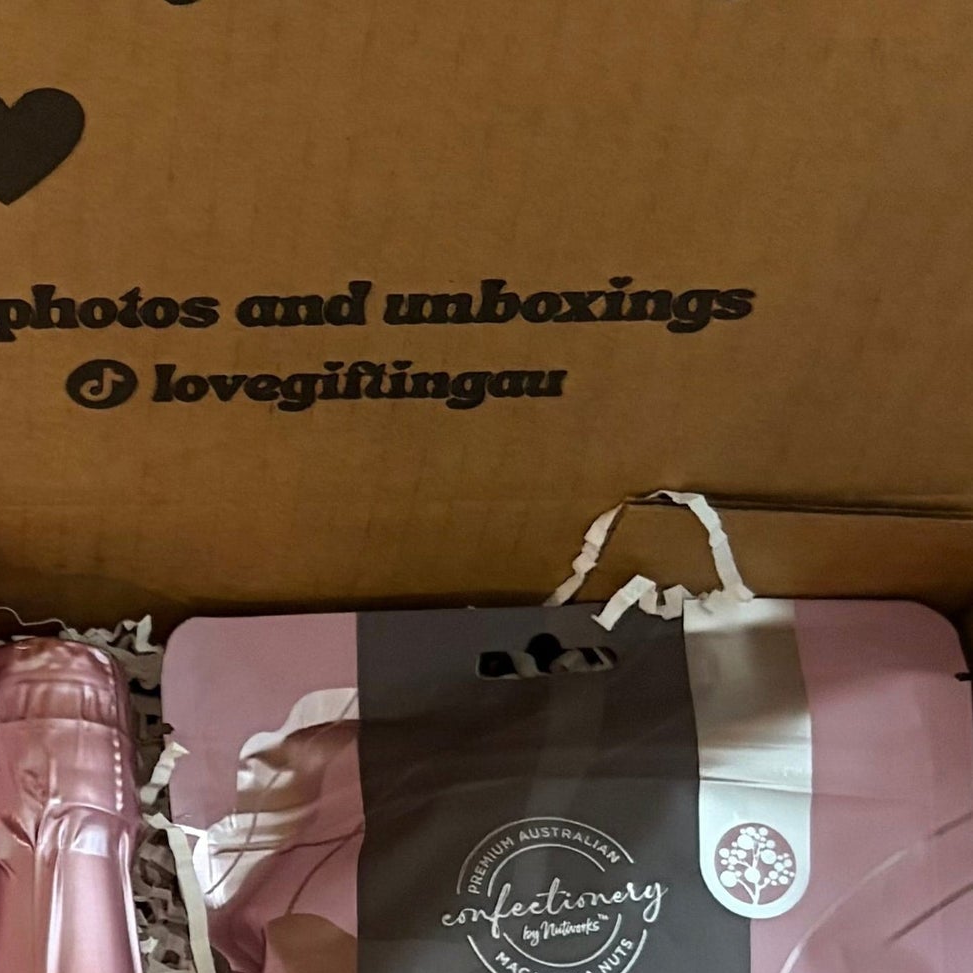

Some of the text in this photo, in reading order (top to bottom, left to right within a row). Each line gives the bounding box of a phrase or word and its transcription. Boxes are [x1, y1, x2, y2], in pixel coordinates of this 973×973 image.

[236, 280, 372, 327] and
[382, 276, 757, 333] unboxings
[151, 359, 568, 412] lovegiftingau
[467, 826, 621, 894] PREMIUM AUSTRALIAN
[441, 877, 669, 939] confectionery
[523, 926, 539, 946] by
